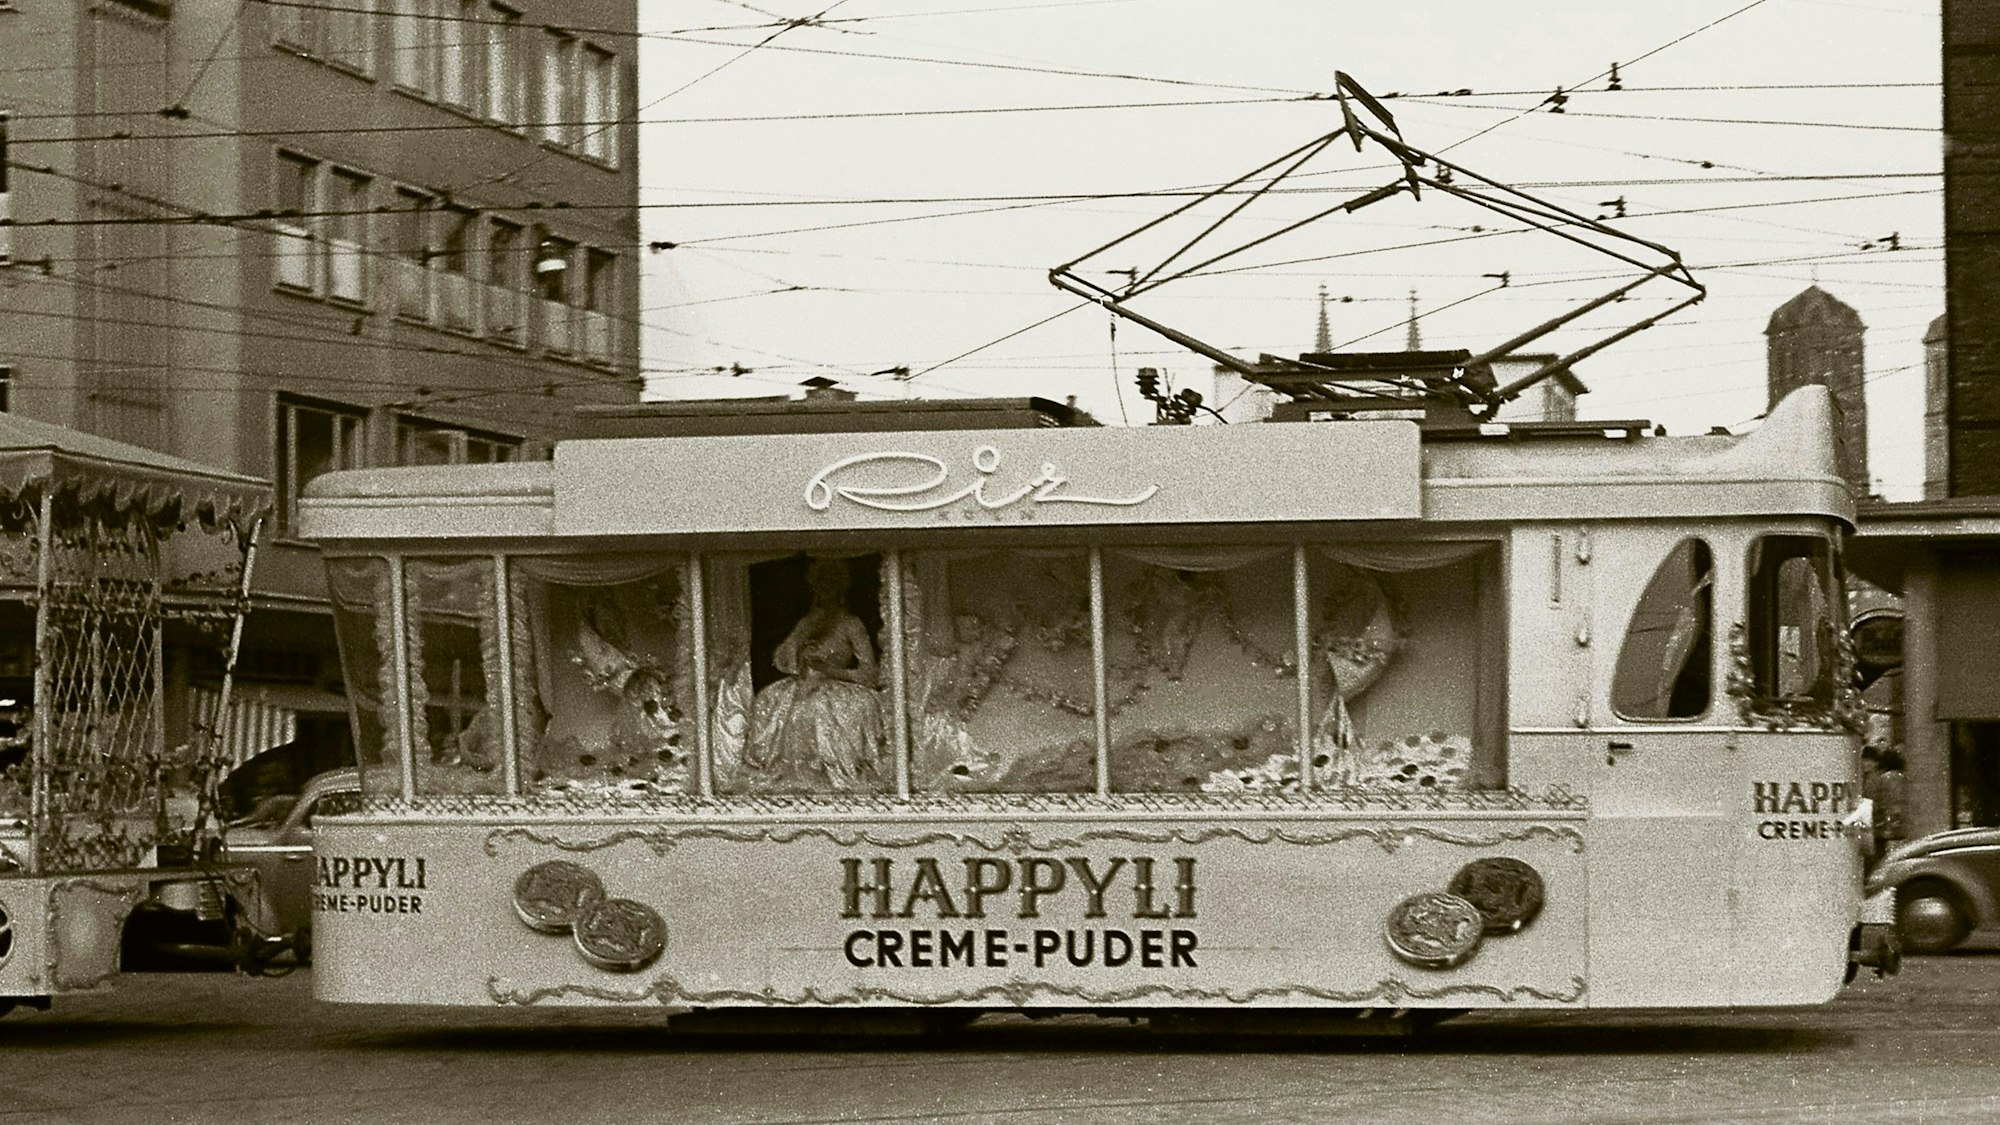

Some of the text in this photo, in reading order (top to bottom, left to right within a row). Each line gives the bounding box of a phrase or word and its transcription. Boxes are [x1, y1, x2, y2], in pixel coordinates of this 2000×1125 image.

[312, 857, 426, 889] APPYLI
[840, 857, 1197, 918] HAPPYLI
[844, 929, 1198, 968] CREME-PUDER
